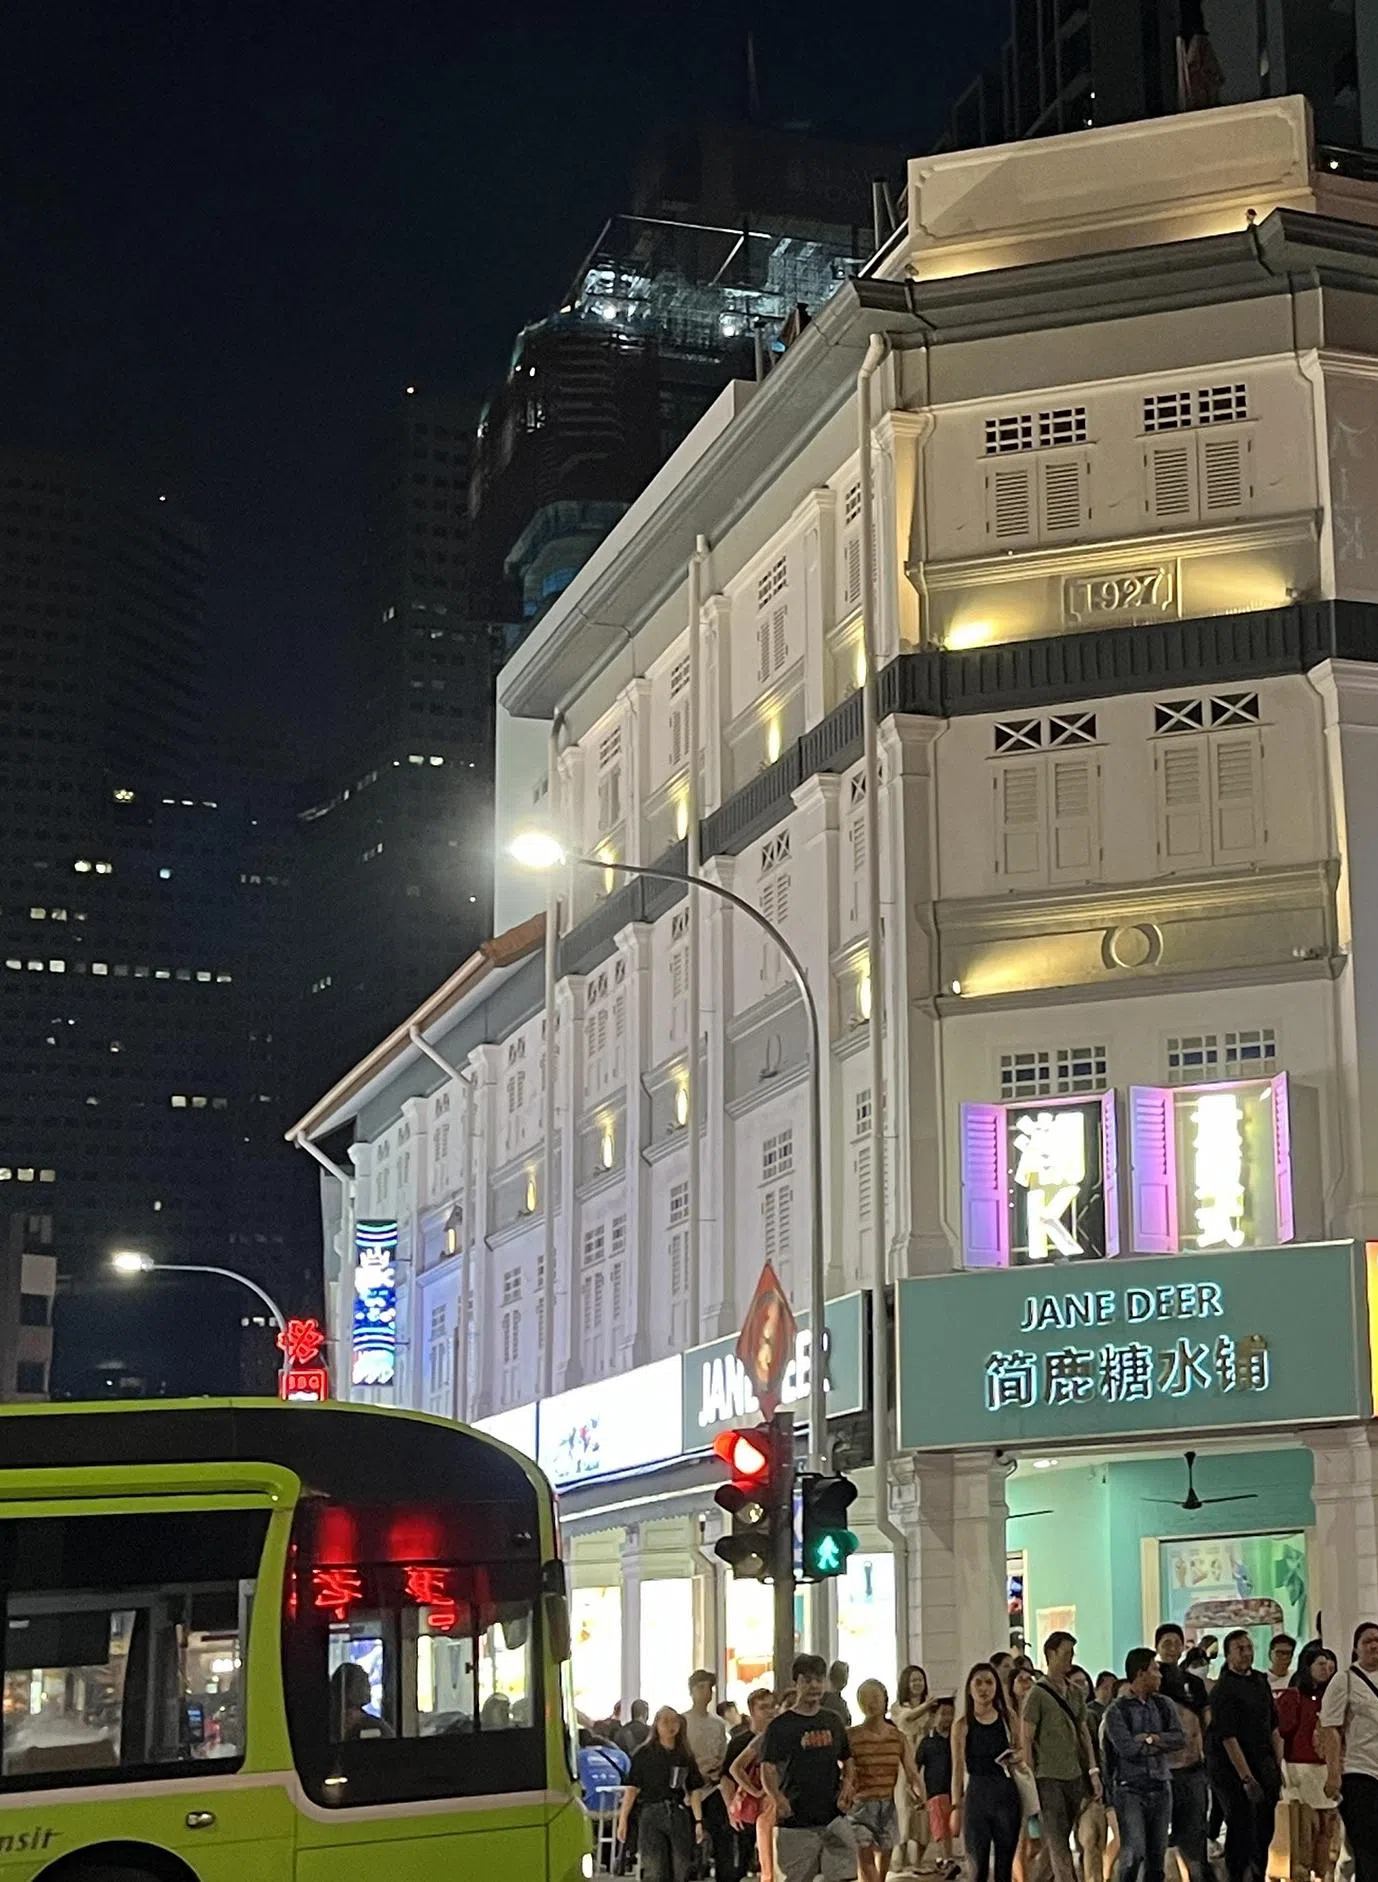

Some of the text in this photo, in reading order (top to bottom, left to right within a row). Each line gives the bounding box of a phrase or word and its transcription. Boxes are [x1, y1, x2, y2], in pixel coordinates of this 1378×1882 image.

[1086, 575, 1164, 612] 1927
[1020, 1282, 1224, 1332] JANE DEER
[985, 1334, 1270, 1411] 简鹿糖水铺
